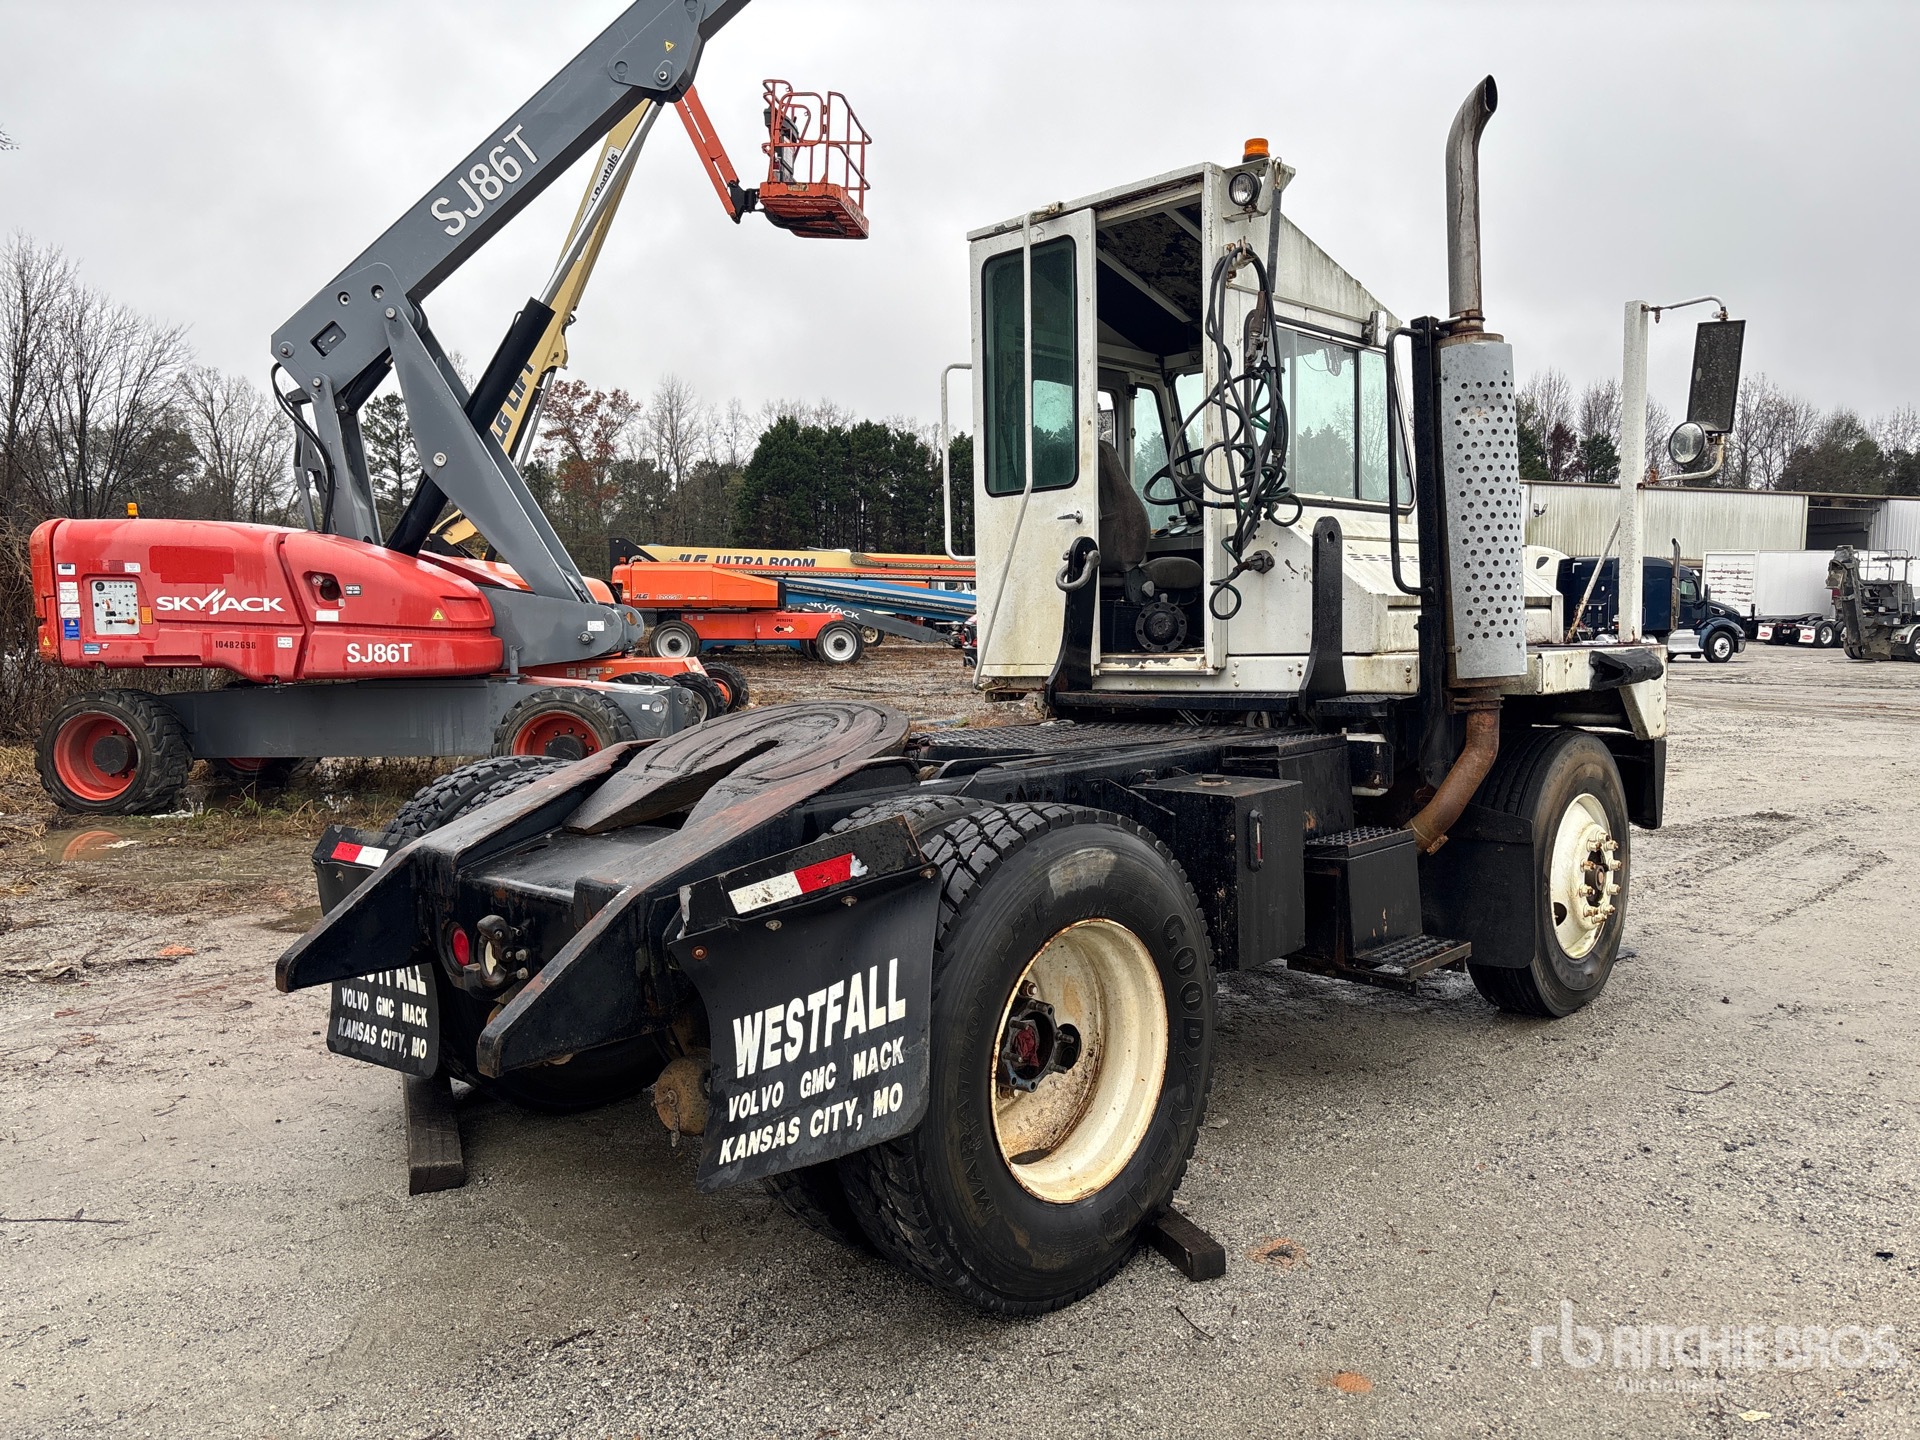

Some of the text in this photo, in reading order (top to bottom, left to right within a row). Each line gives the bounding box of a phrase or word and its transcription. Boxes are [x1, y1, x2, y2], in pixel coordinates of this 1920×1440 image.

[430, 123, 539, 236] SJ86T
[716, 555, 764, 566] ULTRA
[768, 557, 816, 568] BOOM
[156, 588, 286, 615] SKYJACK
[215, 640, 257, 650] 10482698
[346, 643, 413, 663] SJ86T
[342, 987, 428, 1028] VOLVO GMC MACK
[733, 957, 906, 1079] WESTFALL
[338, 1017, 428, 1059] KANSAS CITY, MO
[728, 1036, 905, 1123] VOLVO GMC MACK
[718, 1082, 904, 1165] KANSAS CITY, MO
